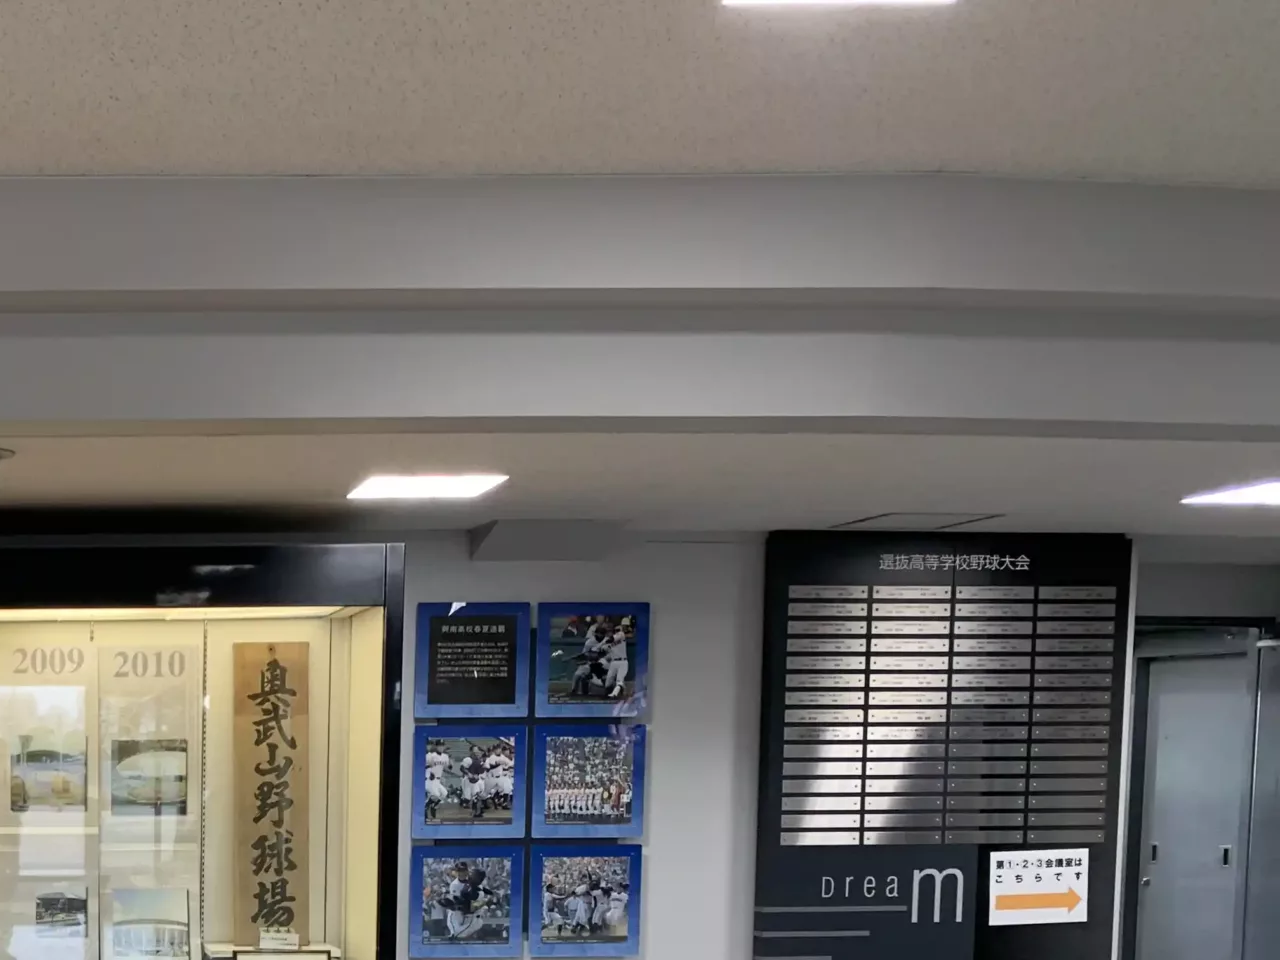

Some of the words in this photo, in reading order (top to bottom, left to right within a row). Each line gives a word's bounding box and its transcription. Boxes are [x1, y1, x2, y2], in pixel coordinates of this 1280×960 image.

[878, 553, 1031, 572] 選抜高等学校野球大会
[12, 646, 85, 675] 2009
[112, 649, 187, 679] 2010
[995, 871, 1083, 884] こちらです
